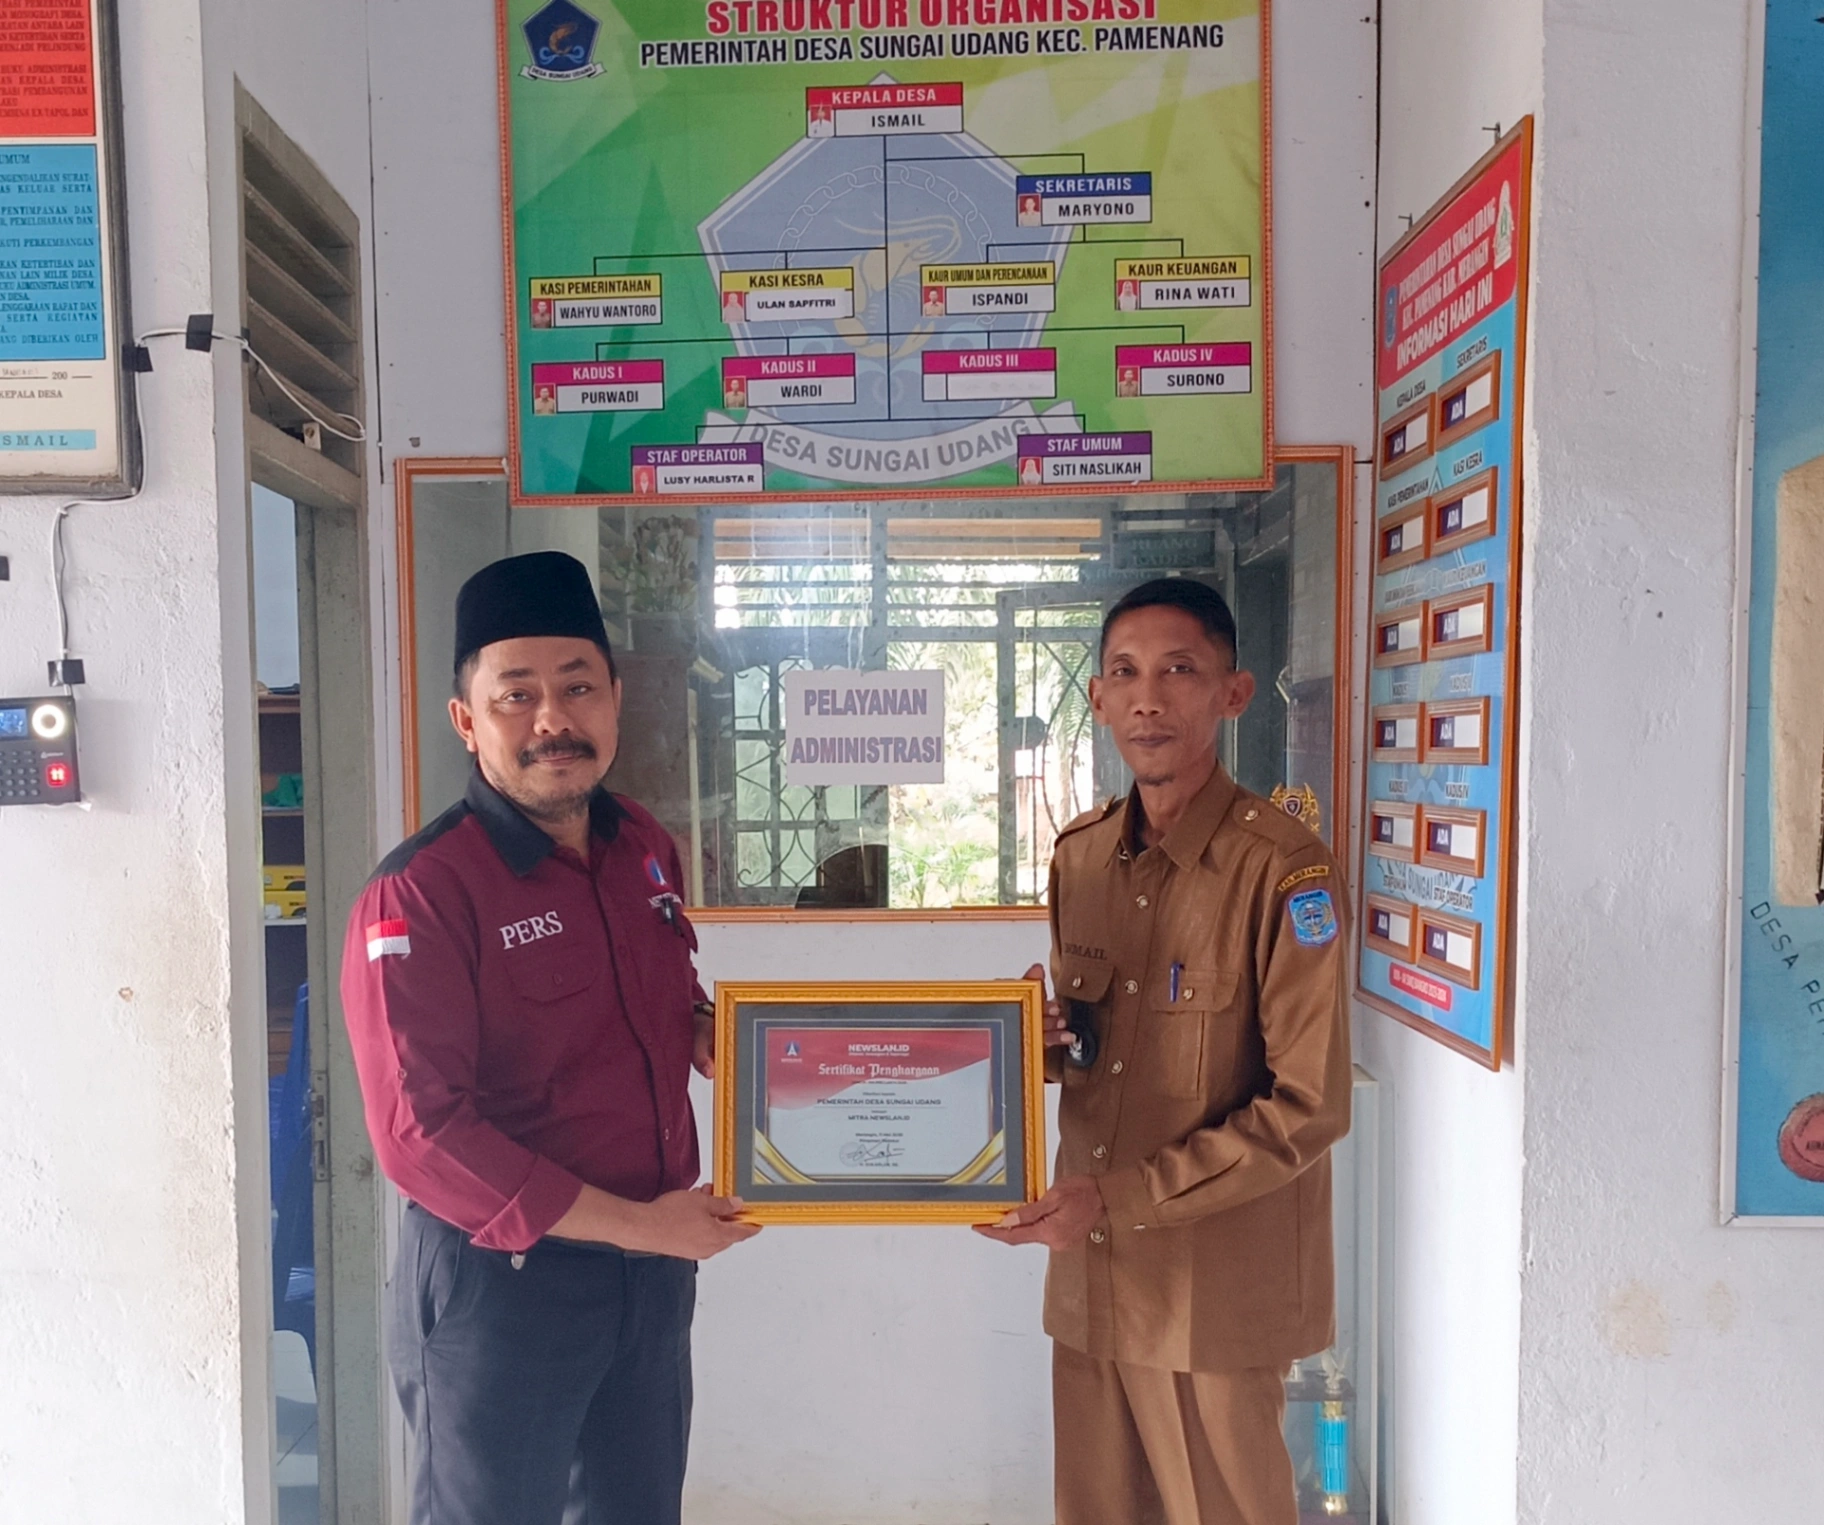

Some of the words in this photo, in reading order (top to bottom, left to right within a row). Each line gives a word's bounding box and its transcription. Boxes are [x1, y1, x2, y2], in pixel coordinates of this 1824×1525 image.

[707, 0, 908, 33] STRUKTUR
[920, 0, 1157, 27] ORGANISASI
[641, 39, 786, 66] PEMERINTAH
[795, 37, 852, 62] DESA
[861, 34, 944, 60] SUNGAI
[952, 31, 1028, 57] UDANG
[1036, 29, 1087, 53] KEC.
[1095, 25, 1224, 50] PAMENANG
[19, 76, 54, 84] KEPALA
[832, 89, 892, 104] KEPALA
[896, 88, 936, 102] DESA
[872, 113, 925, 128] ISMAIL
[0, 173, 60, 182] NGENDALIKAN
[1035, 177, 1132, 193] SEKRETARIS
[18, 184, 55, 194] KELUAR
[62, 184, 92, 193] SERTA
[1, 206, 68, 215] PENYIMPANAN
[74, 205, 93, 214] DAN
[1058, 202, 1135, 217] MARYONO
[76, 216, 93, 225] DAN
[24, 238, 94, 247] PERKEMBANGAN
[20, 260, 74, 268] KETERTIBAN
[77, 259, 96, 268] DAN
[1128, 263, 1165, 277] KAUR
[1167, 261, 1237, 276] KEUANGAN
[20, 270, 40, 280] LAIN
[44, 270, 68, 279] MILIK
[749, 275, 781, 288] KASI
[782, 273, 824, 287] KESRA
[928, 269, 950, 283] KAUR
[951, 269, 973, 282] UMUM
[975, 268, 991, 281] DAN
[992, 267, 1047, 280] PERENCANAAN
[16, 281, 69, 290] ADMINISTRASI
[540, 281, 566, 296] KASI
[568, 279, 652, 294] PEMERINTAHAN
[972, 292, 1028, 306] ISPANDI
[1155, 288, 1194, 301] RINA
[1197, 286, 1235, 300] WATI
[52, 302, 78, 311] RAPAT
[80, 302, 97, 311] DAN
[757, 300, 785, 309] ULAN
[788, 299, 836, 308] SAPFITRI
[7, 313, 38, 322] SERTA
[47, 312, 98, 322] KEGIATAN
[560, 306, 600, 320] WAHYU
[602, 304, 657, 318] WANTORO
[1397, 307, 1448, 371] INFORMASI
[1450, 289, 1475, 332] HARI
[1477, 271, 1493, 312] INI
[22, 334, 70, 344] DIBERIKAN
[75, 334, 98, 343] OLEH
[1153, 349, 1198, 363] KADUS
[1199, 348, 1213, 362] IV
[1456, 335, 1488, 368] SEKRETARIS
[761, 360, 805, 374] KADUS
[807, 359, 816, 373] II
[959, 354, 1004, 368] KADUS
[1005, 354, 1019, 367] III
[52, 372, 68, 380] 200
[572, 366, 616, 380] KADUS
[617, 366, 623, 379] I
[1167, 373, 1225, 387] SURONO
[38, 389, 63, 398] DESA
[581, 390, 639, 405] PURWADI
[780, 385, 822, 398] WARDI
[1451, 400, 1464, 421] ADA
[748, 422, 817, 464] DESA
[827, 444, 929, 473] SUNGAI
[943, 419, 1031, 467] UDANG
[1048, 438, 1078, 451] STAF
[1081, 437, 1122, 451] UMUM
[1393, 436, 1404, 453] ADA
[647, 449, 679, 463] STAF
[681, 449, 747, 462] OPERATOR
[1052, 463, 1077, 476] SITI
[1079, 462, 1141, 475] NASLIKAH
[663, 476, 691, 485] LUSY
[693, 475, 745, 484] HARLISTA
[747, 475, 755, 483] R
[1447, 507, 1460, 529] ADA
[1391, 533, 1401, 551] ADA
[1443, 616, 1456, 634] ADA
[1387, 630, 1397, 646] ADA
[804, 688, 928, 716] PELAYANAN
[1384, 725, 1395, 741] ADA
[1440, 722, 1453, 740] ADA
[790, 736, 942, 764] ADMINISTRASI
[1381, 821, 1392, 836] ADA
[1436, 828, 1449, 846] ADA
[1378, 914, 1388, 930] ADA
[500, 910, 563, 950] PERS
[1750, 901, 1799, 969] DESA
[1432, 932, 1445, 951] ADA
[818, 1063, 865, 1076] Sertifikat
[868, 1063, 940, 1078] Penghargaan
